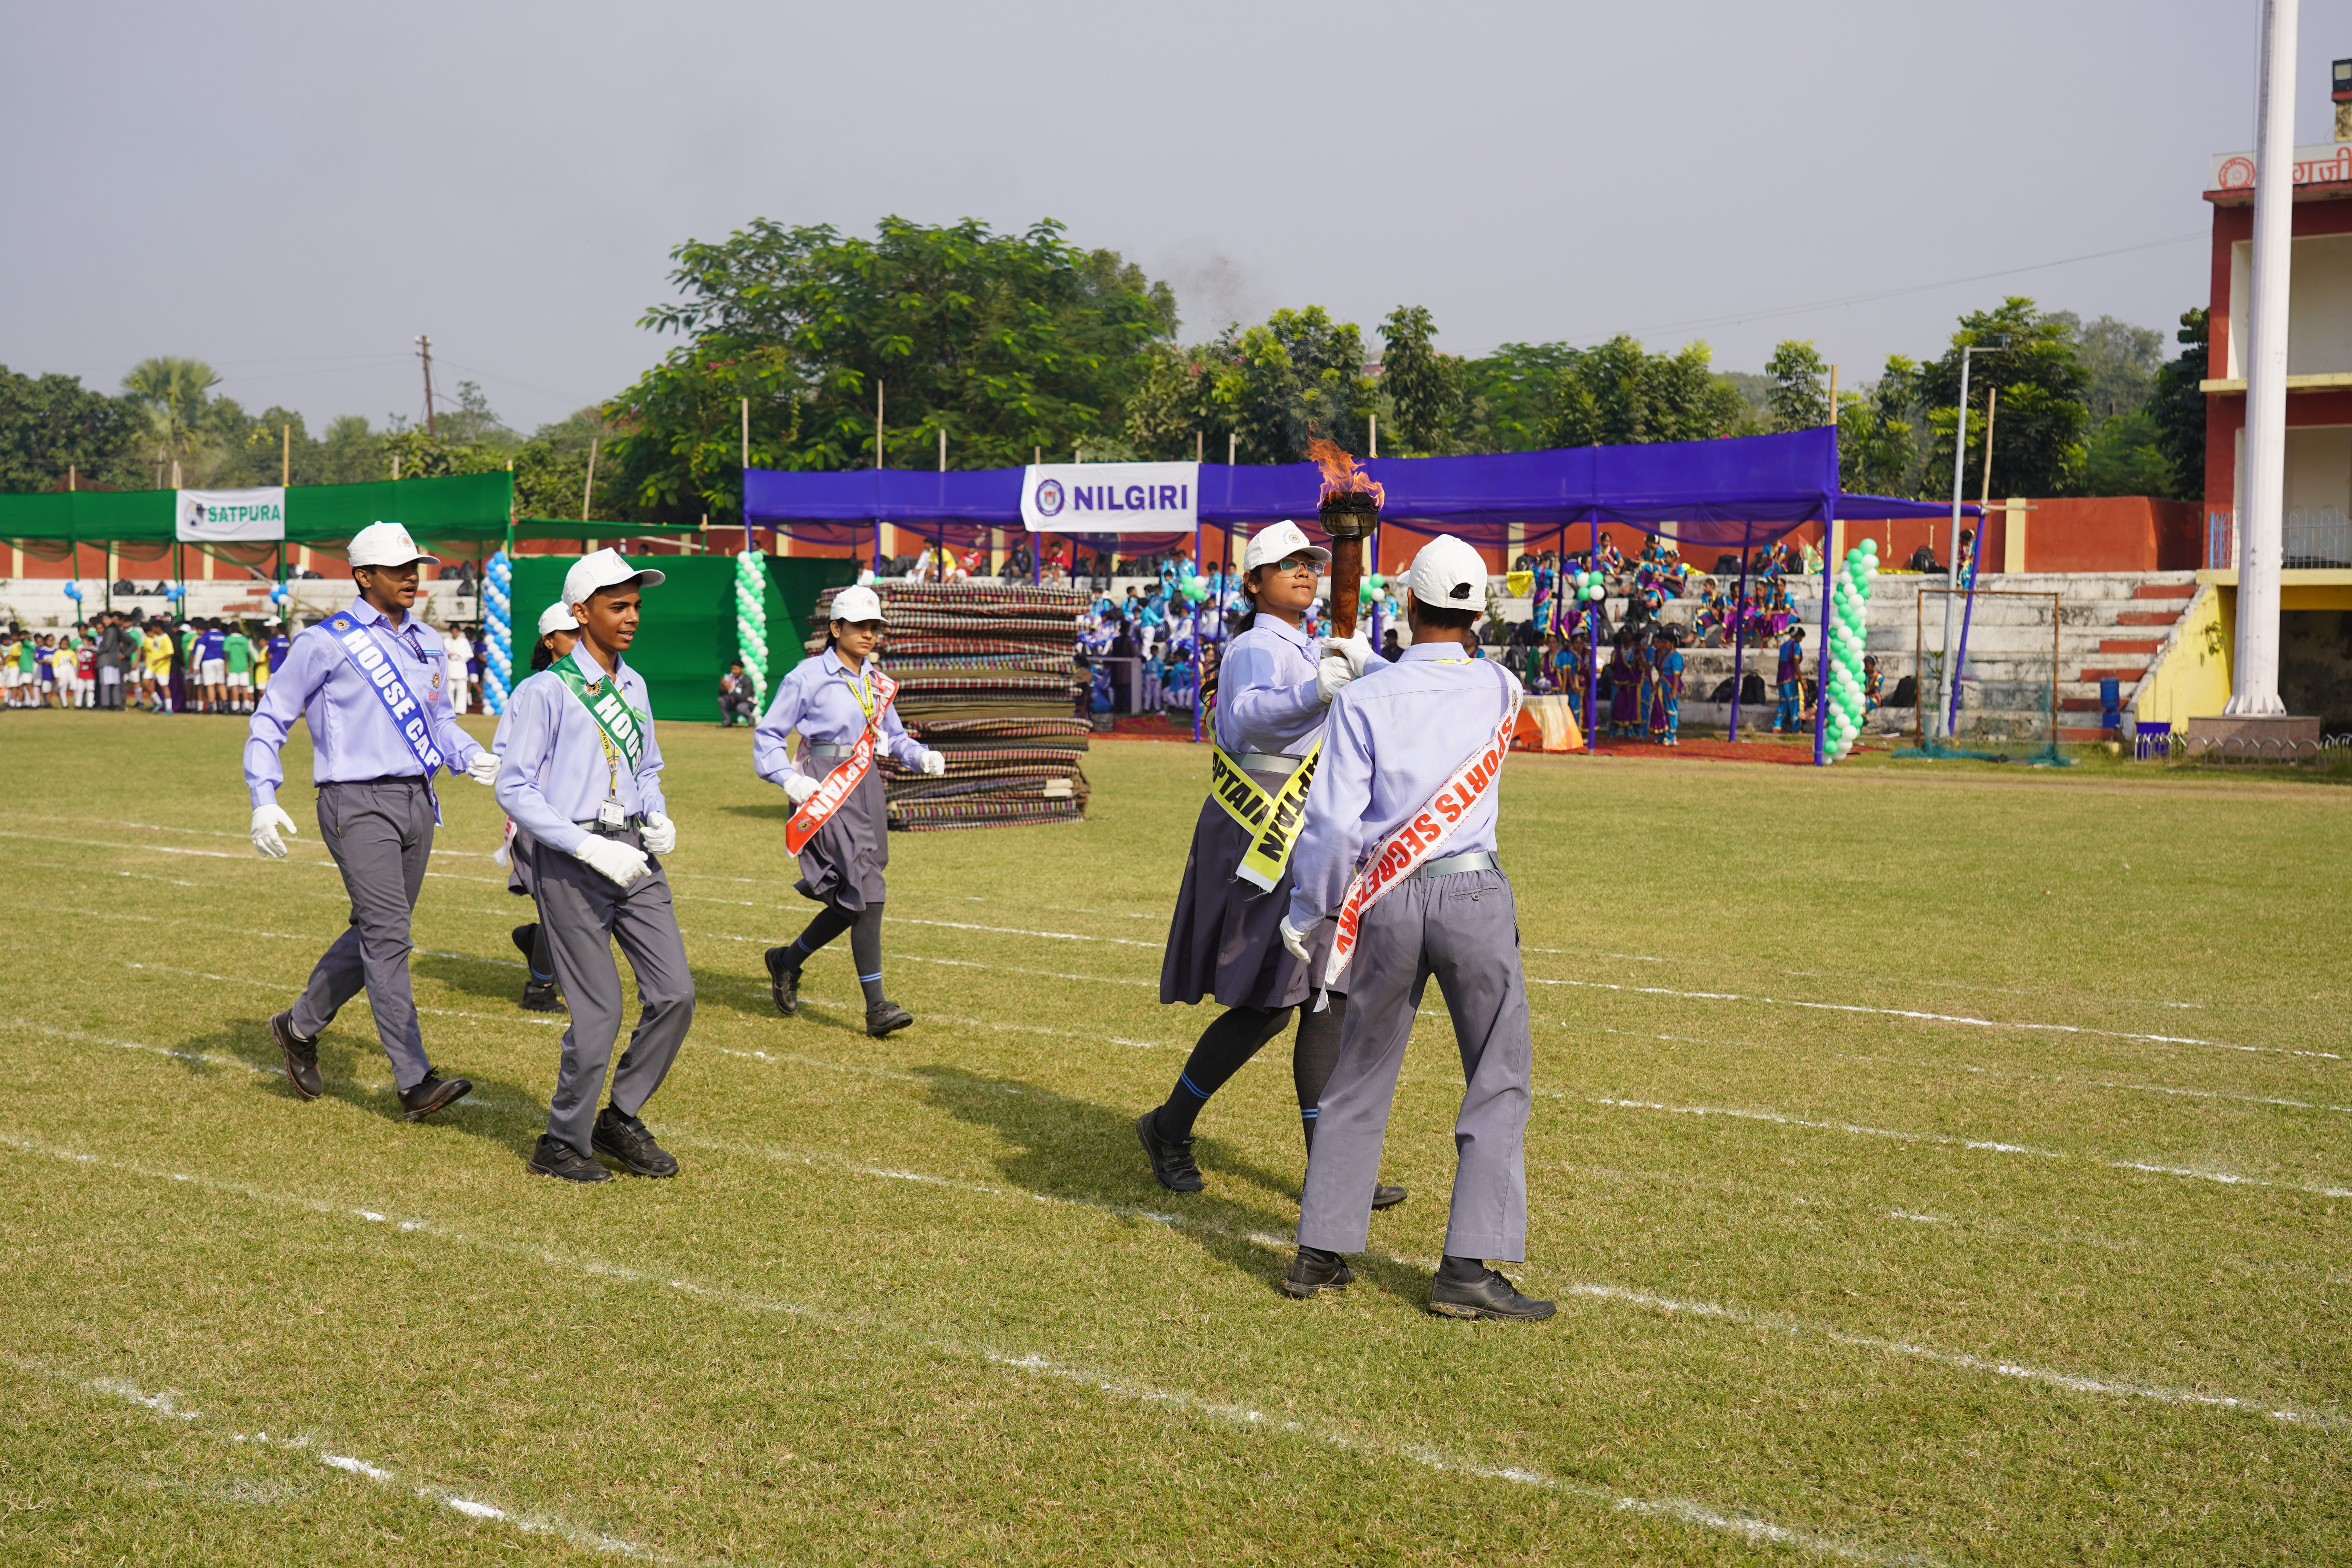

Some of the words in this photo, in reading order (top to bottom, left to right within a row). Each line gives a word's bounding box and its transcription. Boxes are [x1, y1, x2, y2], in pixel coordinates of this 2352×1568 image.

[208, 504, 281, 523] SATPURA
[1074, 485, 1187, 510] NILGIRI
[342, 628, 416, 720] HOUSE
[405, 717, 442, 767] CAP
[806, 739, 870, 821] CAPTAIN
[1435, 715, 1512, 823] SPORTS
